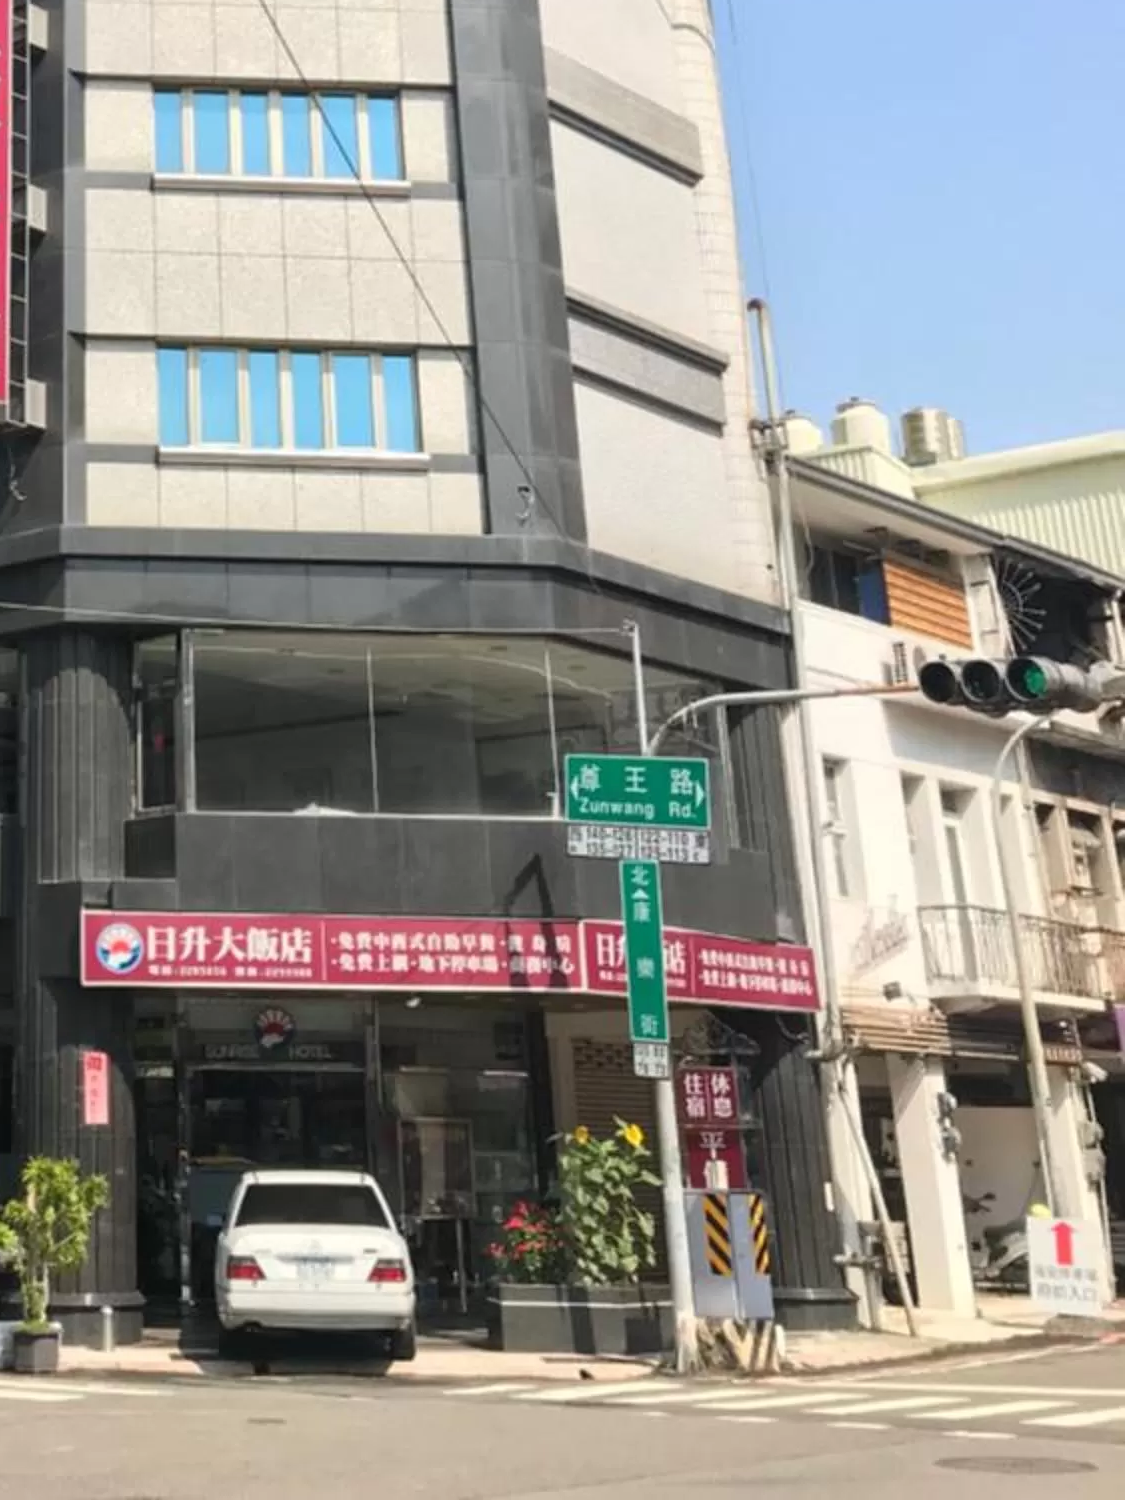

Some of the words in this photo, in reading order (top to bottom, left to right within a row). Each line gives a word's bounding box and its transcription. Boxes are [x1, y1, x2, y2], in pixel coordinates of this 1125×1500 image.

[579, 797, 656, 821] Zunwang
[146, 925, 313, 964] 日升大飯店
[288, 1043, 332, 1060] HOTEL
[683, 1072, 706, 1118] 住宿
[710, 1071, 734, 1118] 休息
